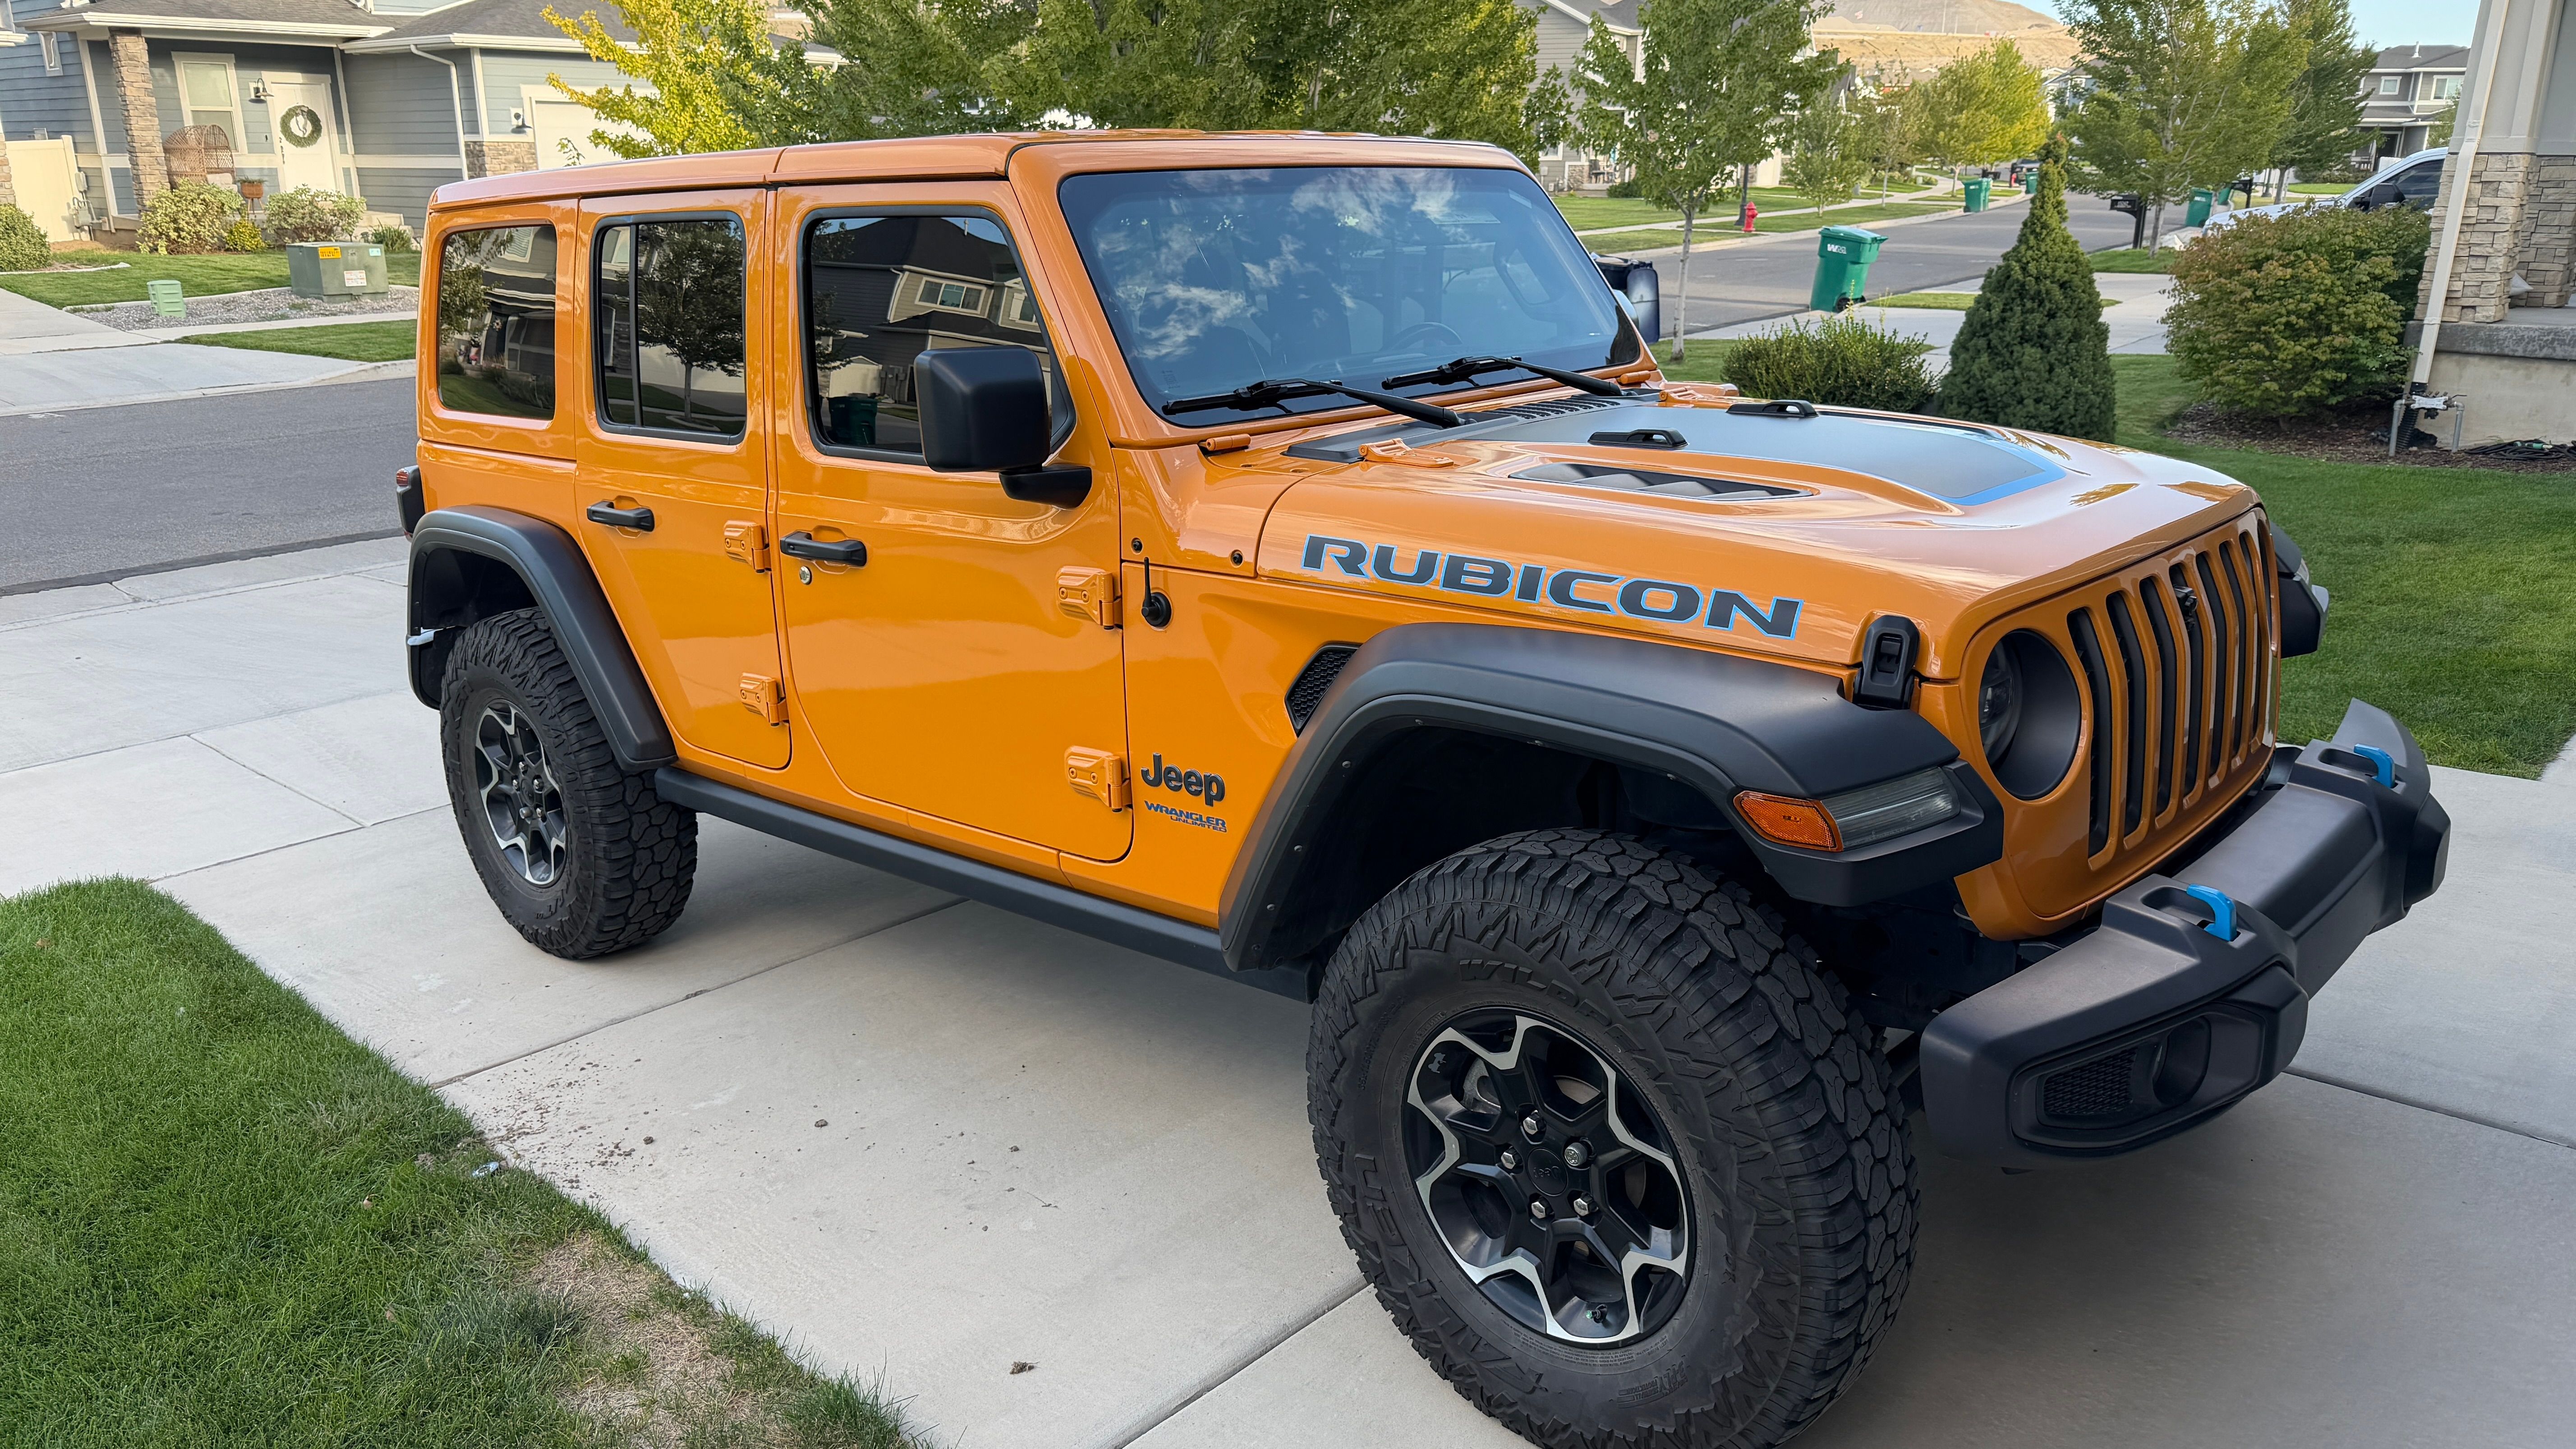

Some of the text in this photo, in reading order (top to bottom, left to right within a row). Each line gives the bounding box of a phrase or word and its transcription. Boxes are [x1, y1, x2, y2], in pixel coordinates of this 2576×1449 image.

[1301, 534, 1803, 640] RUBICON
[1141, 752, 1225, 807] Jeep
[1144, 800, 1226, 828] WRANGLER
[1170, 815, 1227, 833] UNLIMITED
[1458, 959, 1694, 1120] WILDPEAK
[1534, 1165, 1560, 1179] Jeep
